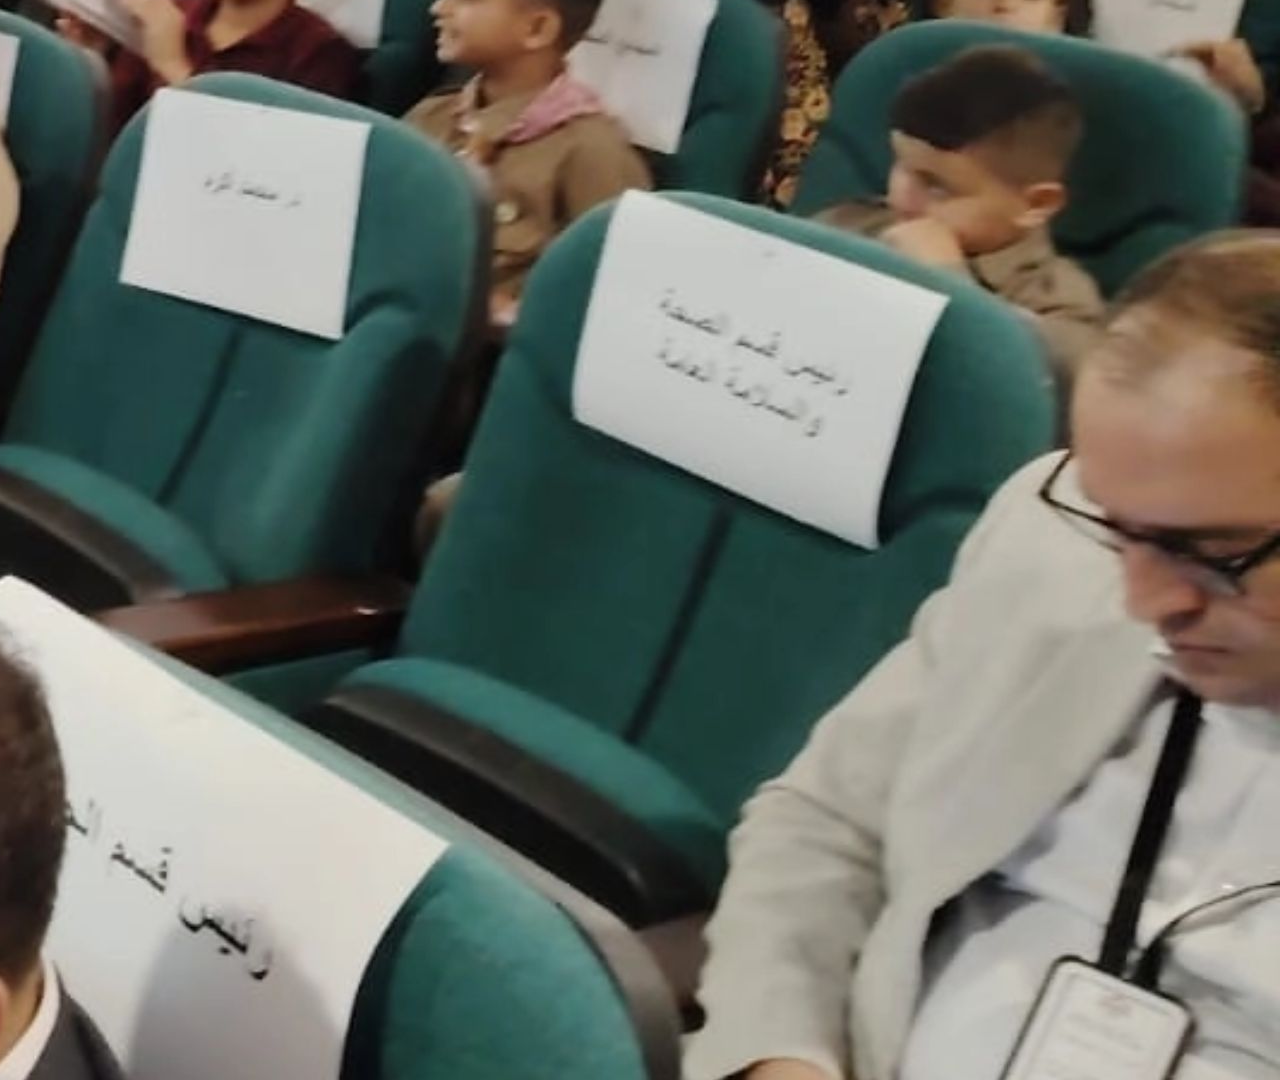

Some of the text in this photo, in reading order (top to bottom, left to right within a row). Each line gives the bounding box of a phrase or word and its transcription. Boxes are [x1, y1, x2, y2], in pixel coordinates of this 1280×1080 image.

[735, 330, 782, 359] قسم
[784, 362, 849, 398] رئيس
[107, 842, 274, 980] رئيس قسم
